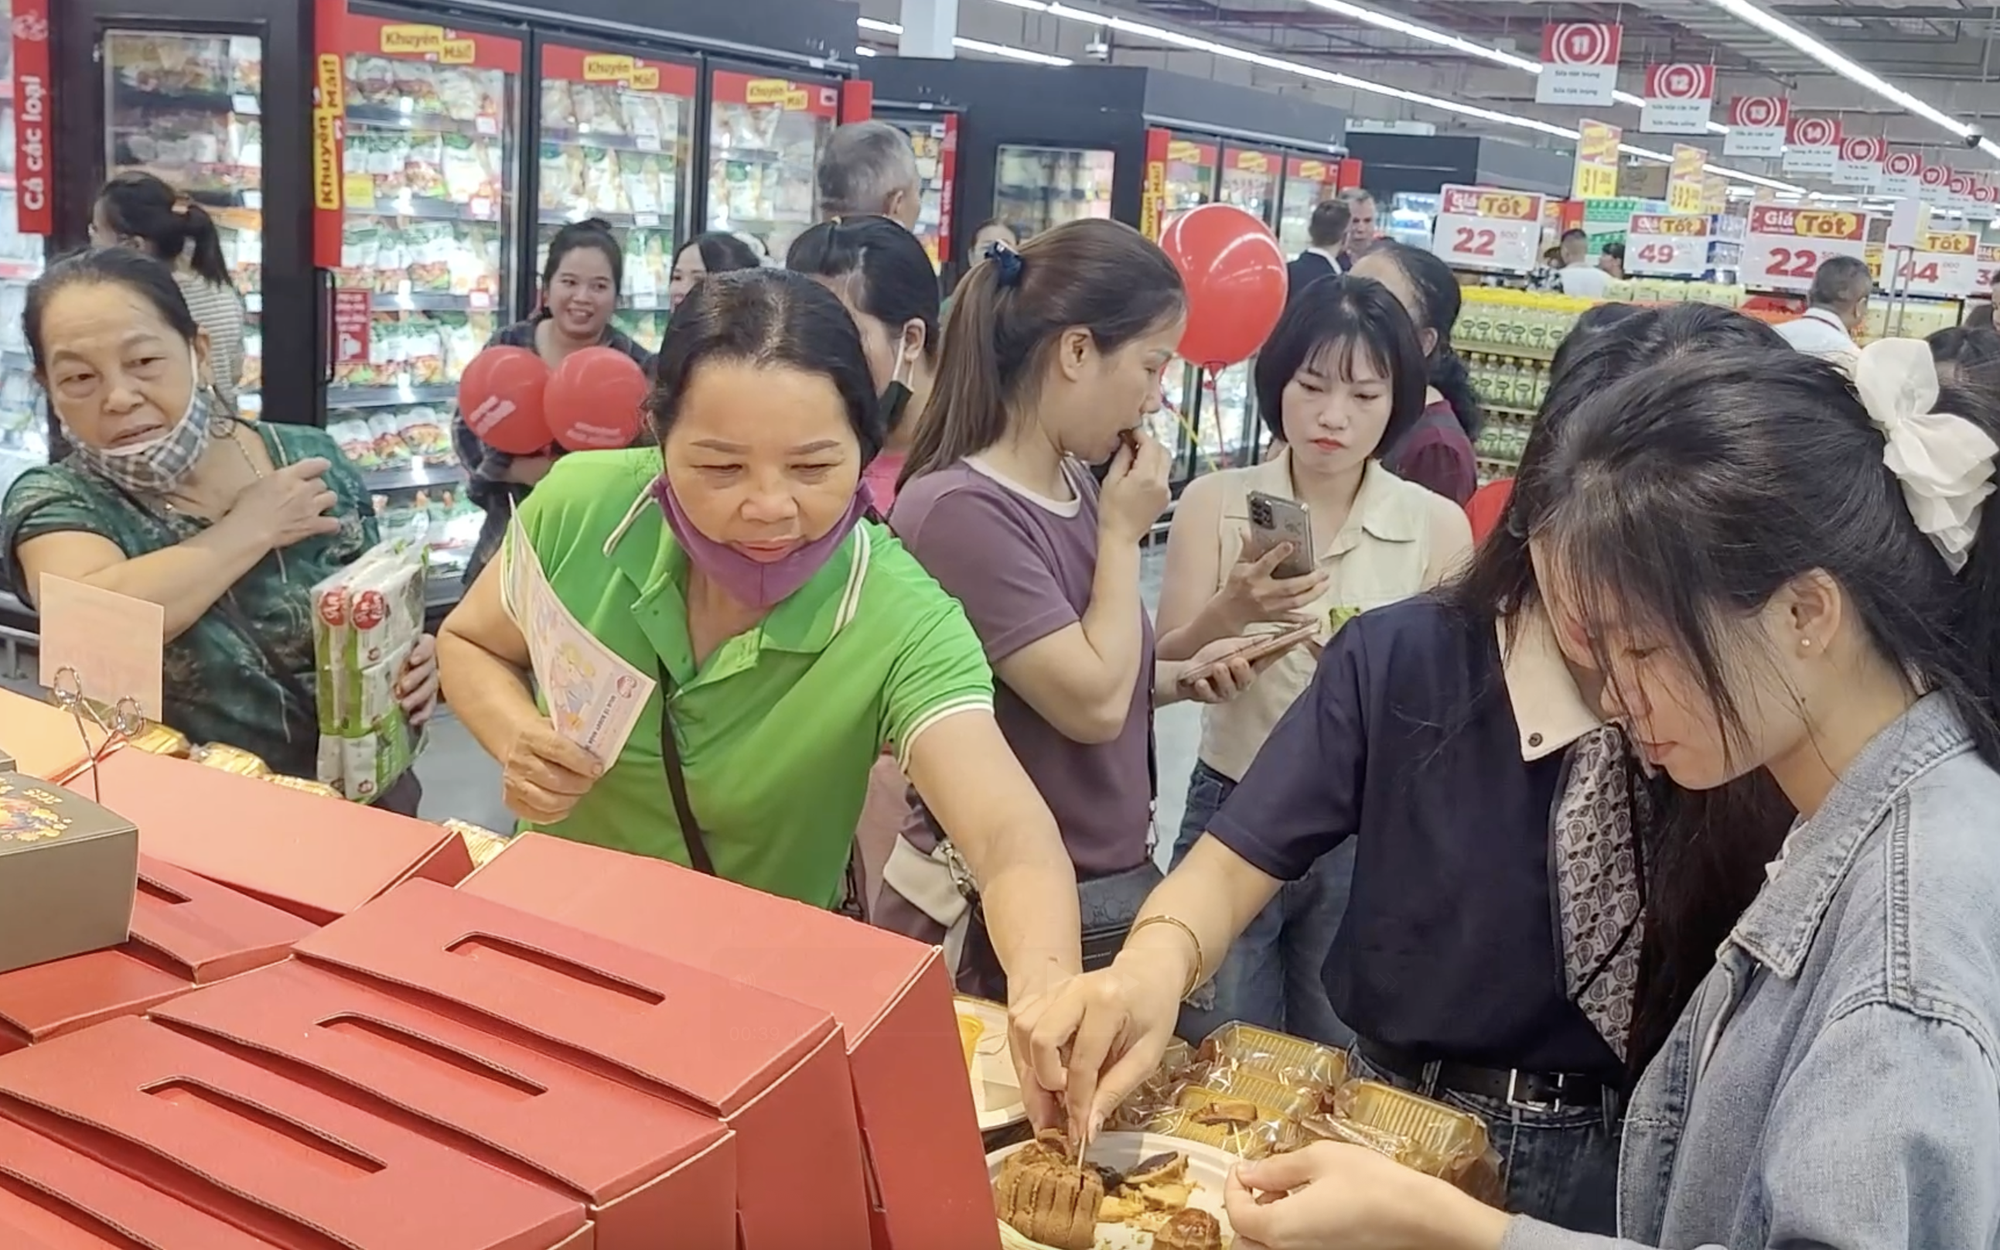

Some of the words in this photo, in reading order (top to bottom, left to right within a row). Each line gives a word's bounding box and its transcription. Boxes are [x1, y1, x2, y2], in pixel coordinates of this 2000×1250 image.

[20, 75, 46, 122] loại
[21, 128, 43, 171] các
[1485, 195, 1522, 215] Tốt
[1664, 217, 1694, 232] Tốt
[1764, 210, 1794, 226] Giá
[1802, 212, 1846, 235] Tốt
[1452, 227, 1496, 256] 22
[1638, 243, 1674, 263] 49
[1928, 234, 1962, 251] Tốt
[1766, 247, 1817, 278] 22
[1898, 261, 1939, 283] 44
